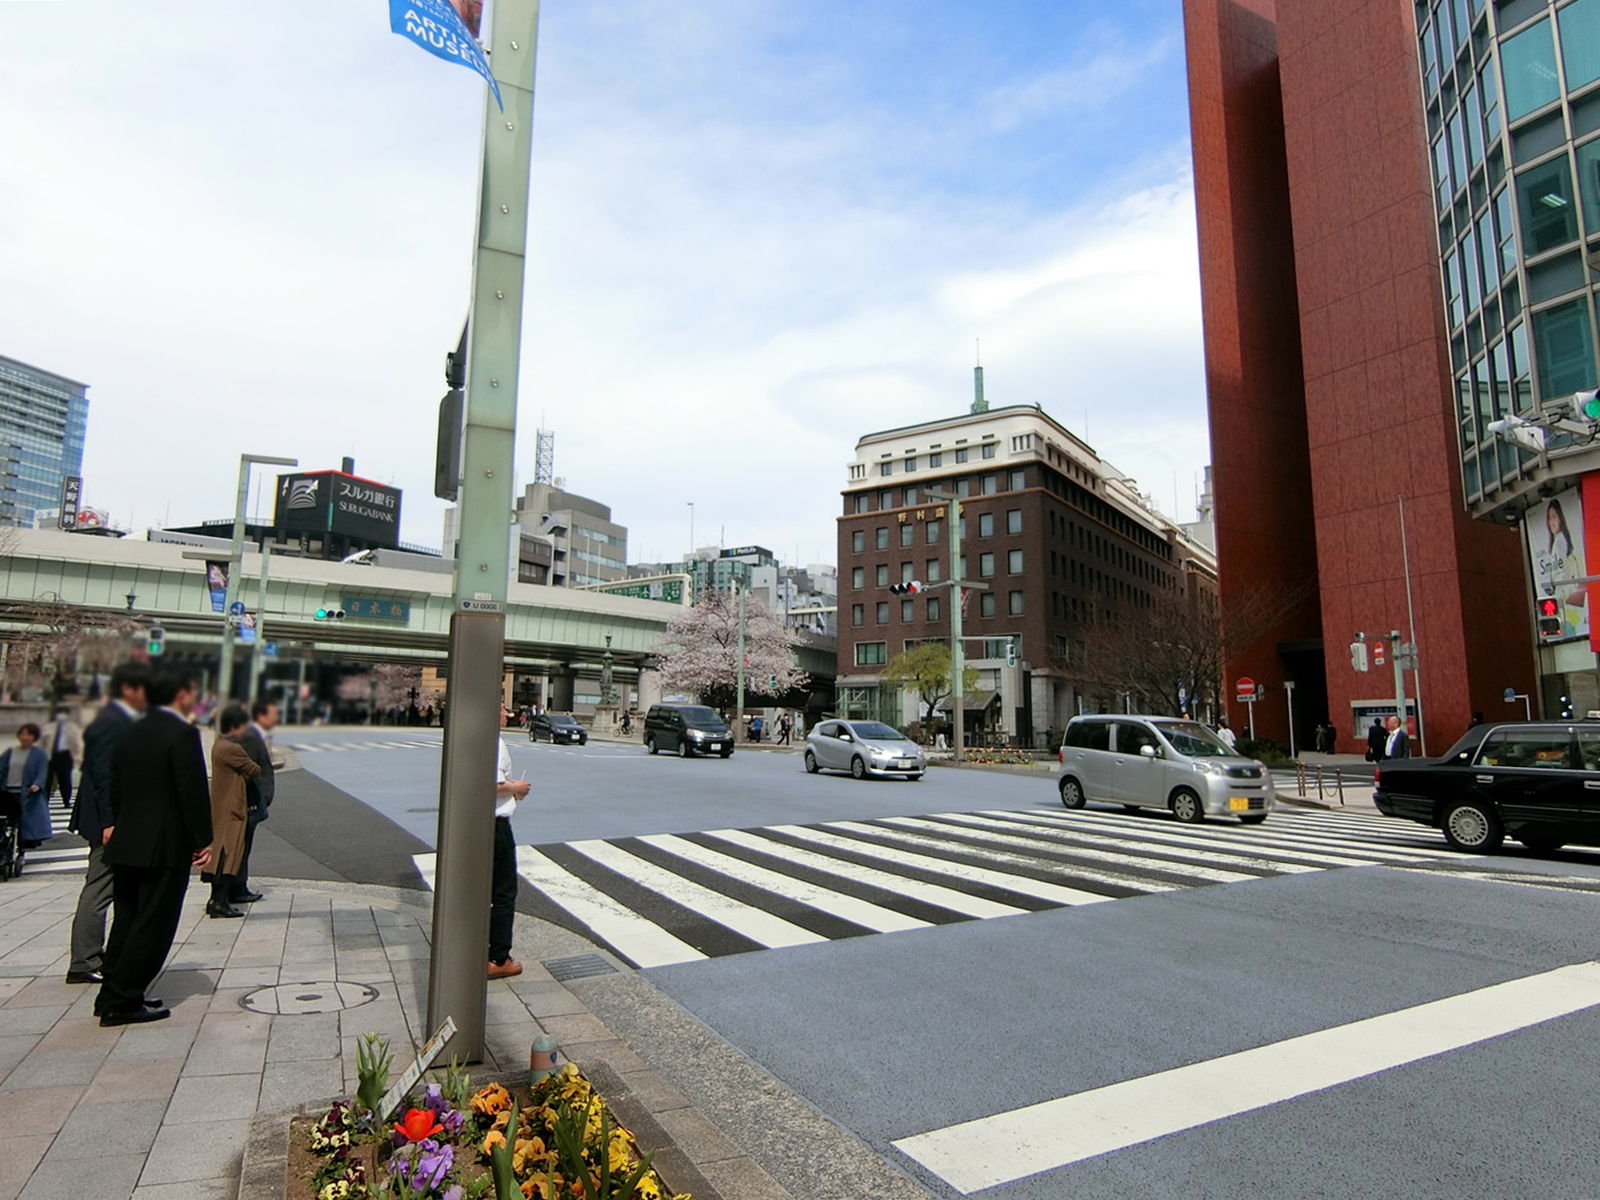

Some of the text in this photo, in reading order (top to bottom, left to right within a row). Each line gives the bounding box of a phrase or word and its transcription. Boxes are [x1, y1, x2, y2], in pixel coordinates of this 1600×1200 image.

[340, 482, 396, 509] スルガ銀行
[351, 601, 403, 617] 日本橋
